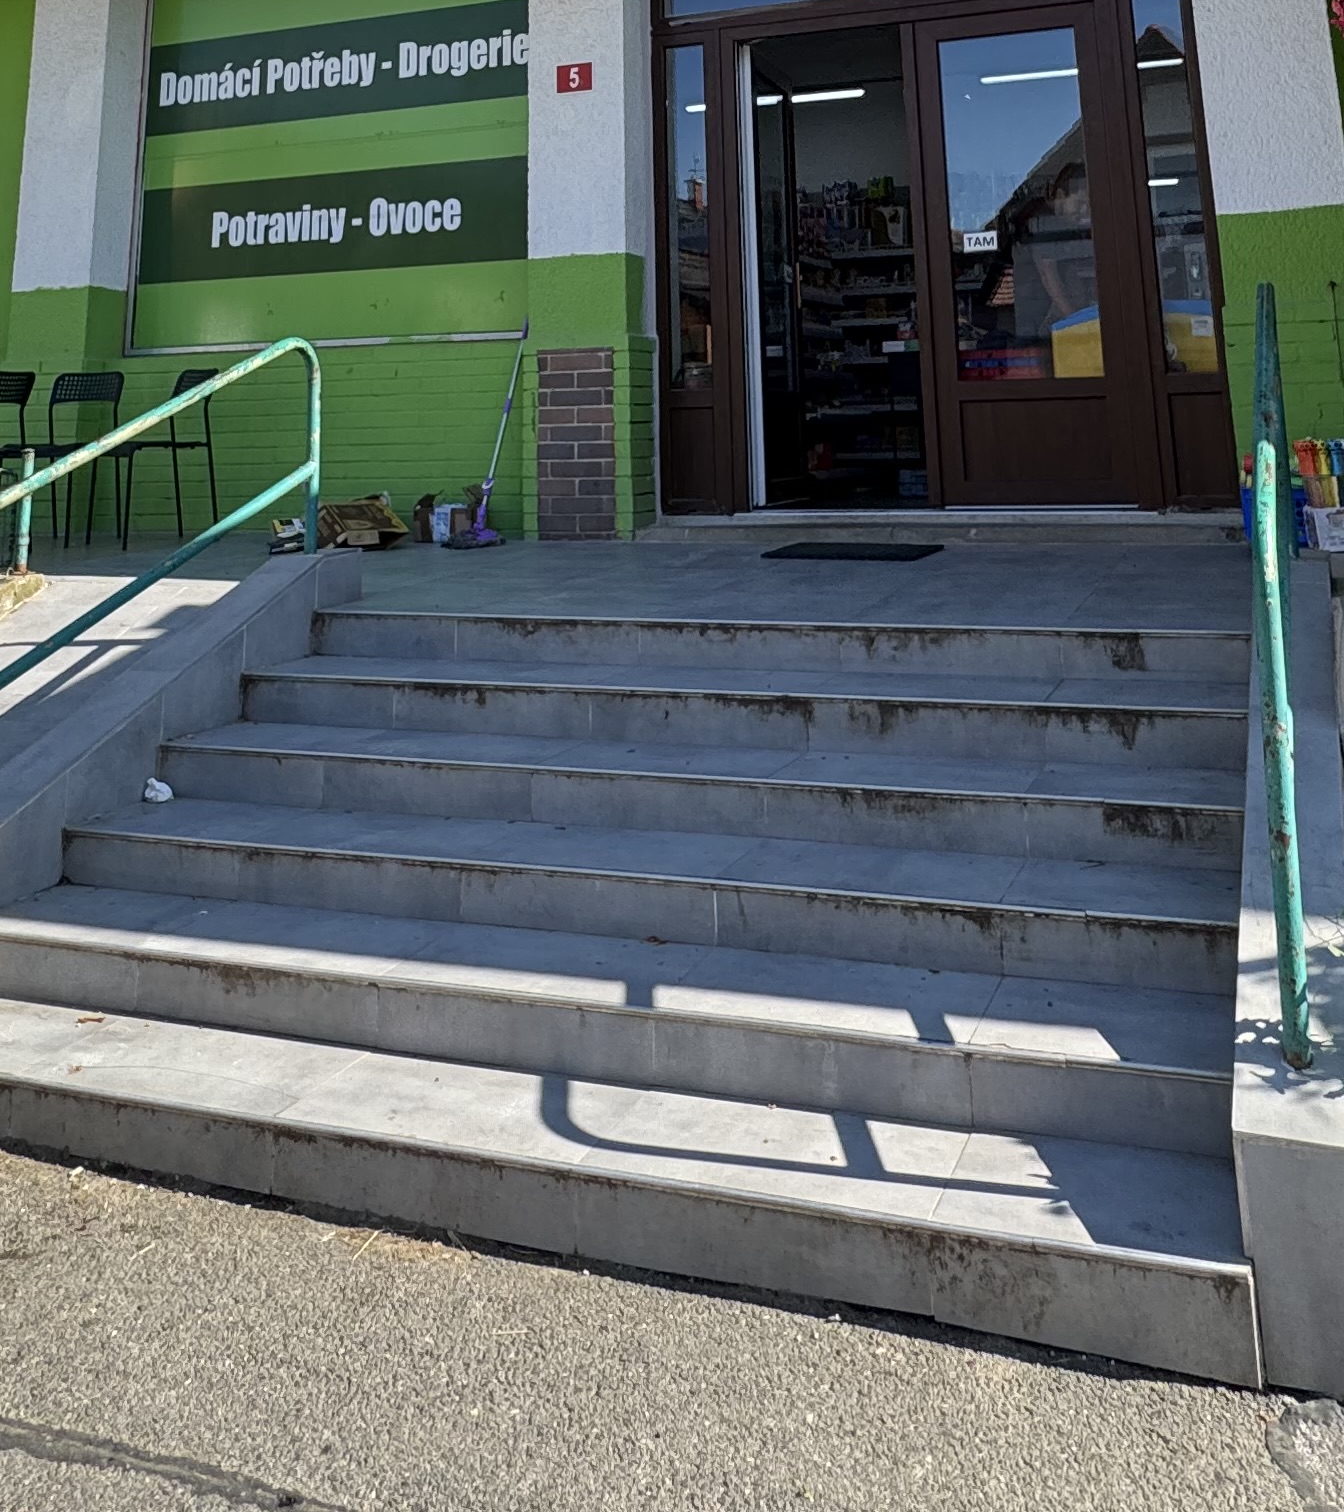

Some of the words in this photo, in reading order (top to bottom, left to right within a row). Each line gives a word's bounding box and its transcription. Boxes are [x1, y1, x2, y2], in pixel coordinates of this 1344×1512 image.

[159, 59, 261, 107] Domácí
[267, 50, 377, 94] Potřeby
[399, 29, 529, 78] Drogerie
[568, 66, 580, 89] 5
[211, 205, 346, 248] Potraviny
[368, 197, 462, 237] Ovoce
[966, 236, 995, 248] TAM
